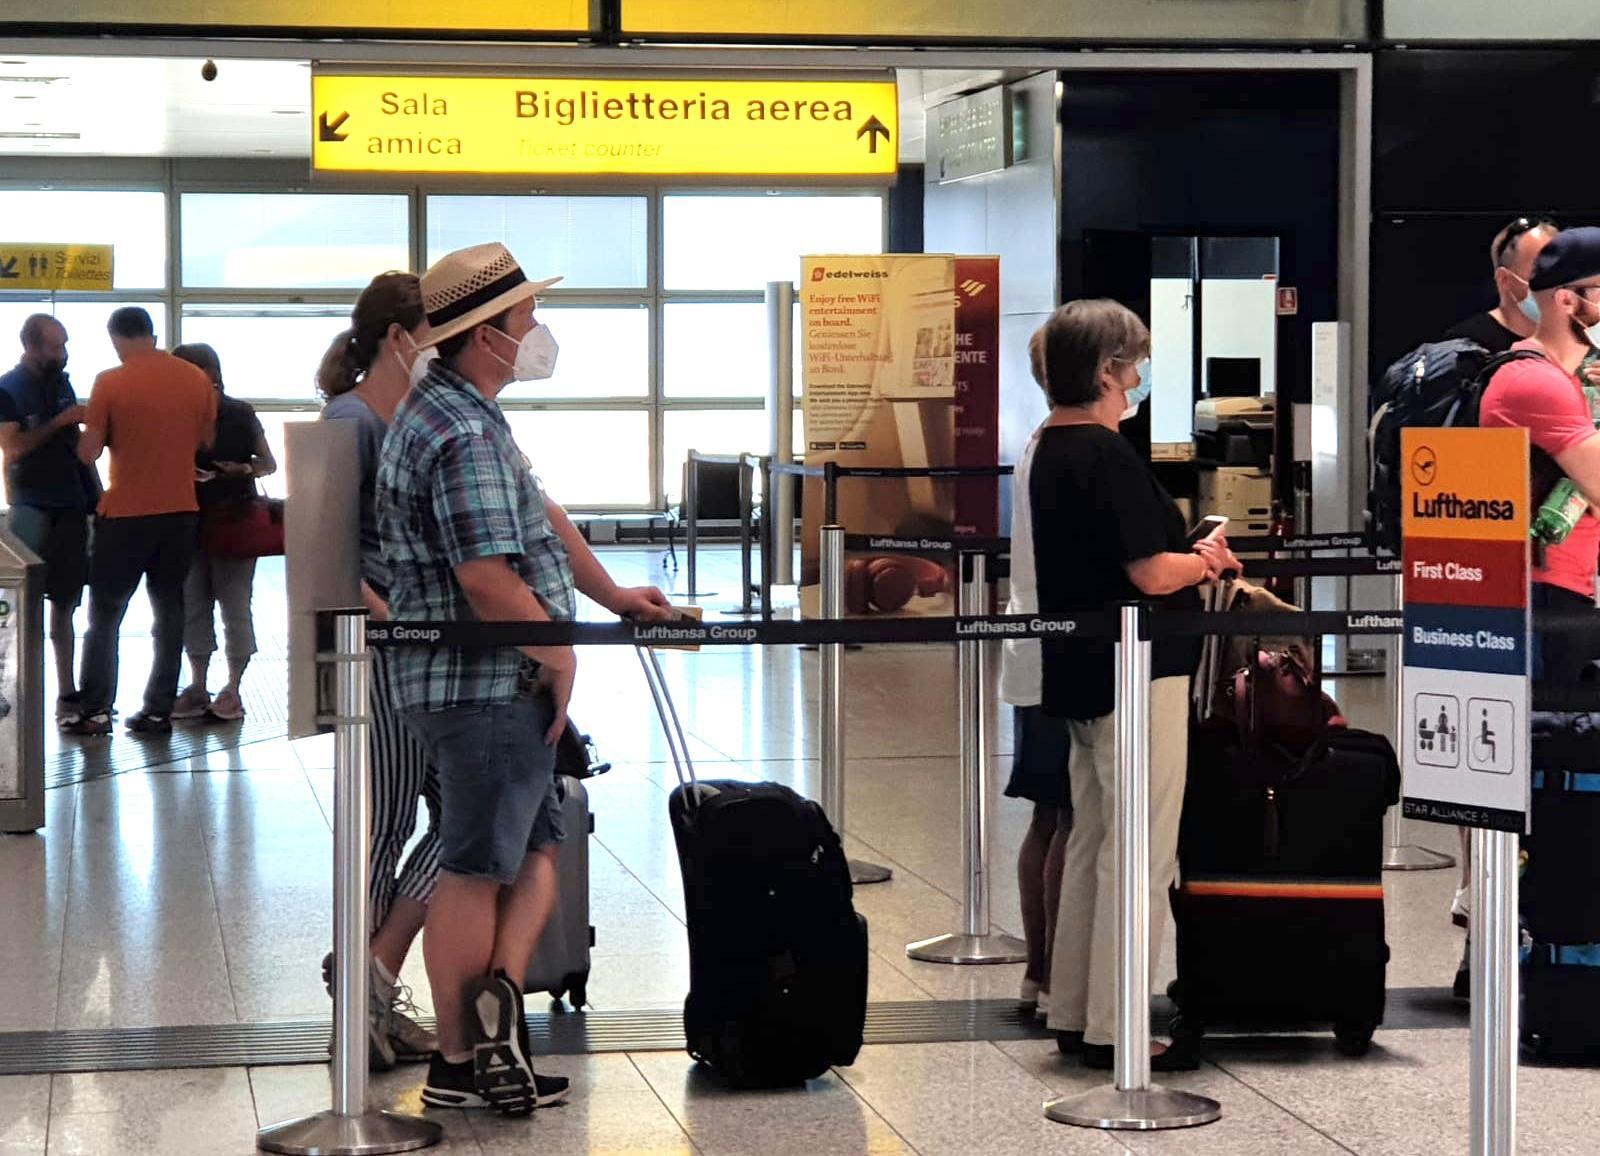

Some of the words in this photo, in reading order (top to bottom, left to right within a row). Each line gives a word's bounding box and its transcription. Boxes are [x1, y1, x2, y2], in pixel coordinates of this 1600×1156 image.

[381, 91, 448, 116] Sala
[515, 90, 730, 126] Biglietteria
[746, 99, 852, 121] aerea
[367, 131, 462, 155] amica
[583, 142, 665, 157] counter
[826, 269, 889, 279] edelweiss
[809, 294, 836, 306] Enjoy
[838, 294, 856, 303] free
[809, 306, 877, 315] entertainment
[1413, 491, 1514, 520] Lufthansa
[870, 538, 918, 548] Lufthansa
[920, 539, 951, 549] Group
[1331, 536, 1362, 546] Group
[1413, 561, 1443, 579] First
[1445, 562, 1483, 582] Class
[633, 626, 706, 639] Lufthansa
[710, 625, 757, 641] Group
[955, 620, 1026, 634] Lufthansa
[1029, 618, 1076, 633] Group
[392, 626, 441, 643] Group
[1413, 626, 1474, 648] Business
[1476, 630, 1515, 651] Class
[1404, 802, 1428, 815] STAR
[1430, 806, 1478, 822] ALLIANCE
